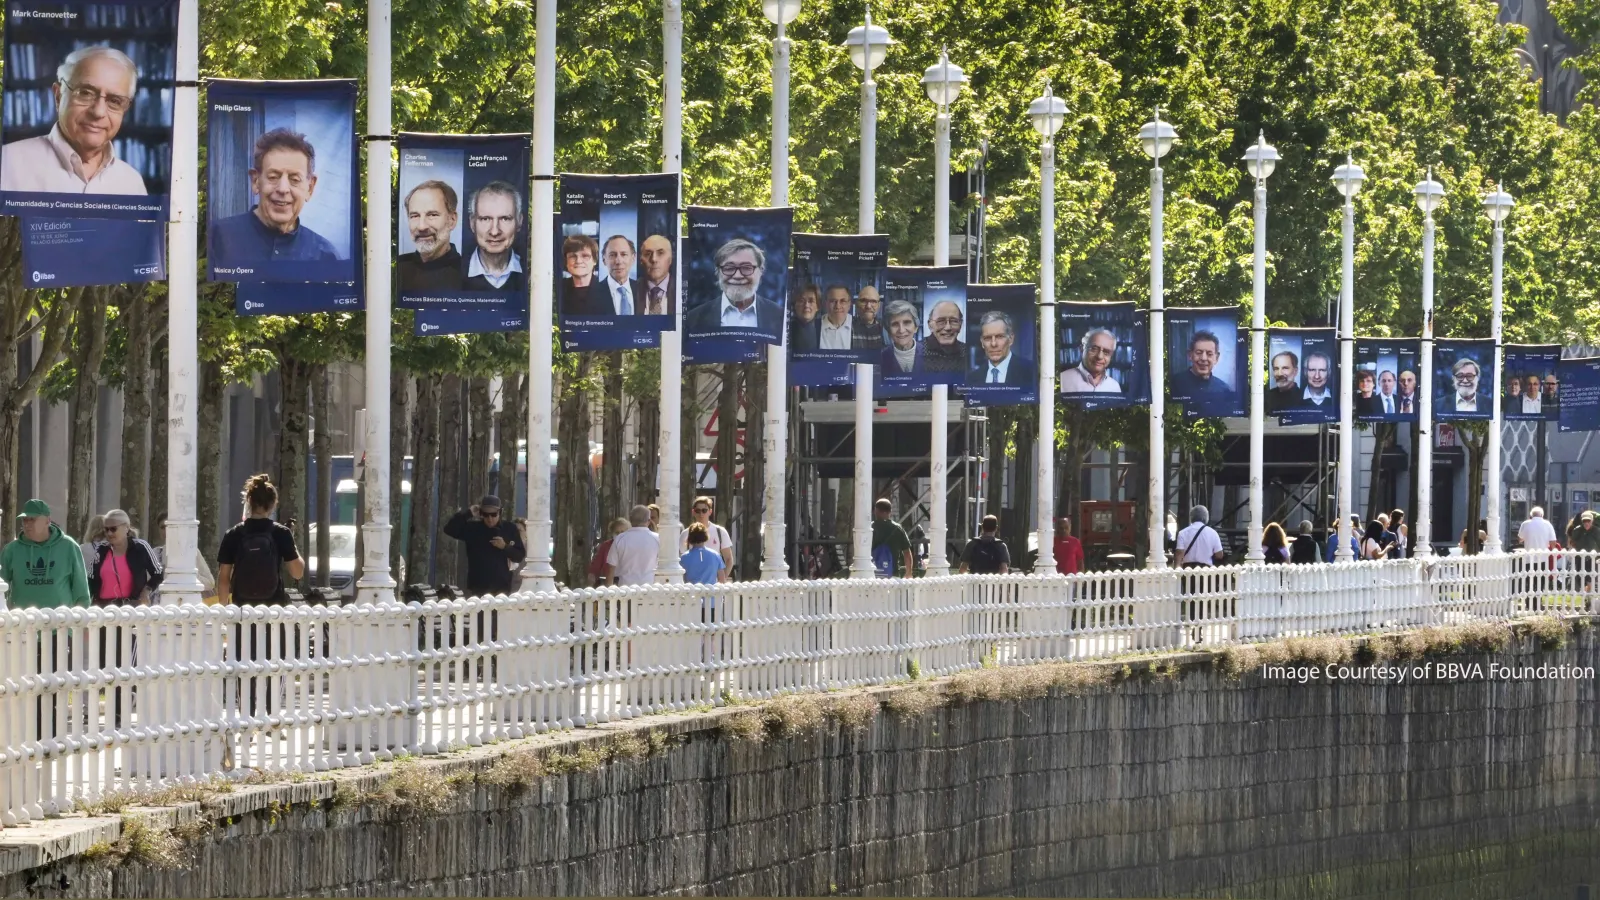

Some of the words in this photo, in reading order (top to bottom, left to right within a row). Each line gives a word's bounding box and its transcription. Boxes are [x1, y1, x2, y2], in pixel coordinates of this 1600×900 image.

[12, 9, 31, 18] Mark
[32, 10, 78, 19] Granovetter
[214, 104, 233, 113] Philip
[5, 199, 50, 208] Humanidades
[55, 201, 83, 209] Ciencias
[84, 202, 111, 210] Sociales
[111, 203, 137, 211] (Ciencias
[137, 204, 162, 212] Sociales)
[30, 223, 43, 231] XIV
[44, 221, 72, 231] Edición
[140, 266, 159, 274] CSIC
[25, 578, 54, 586] adidas
